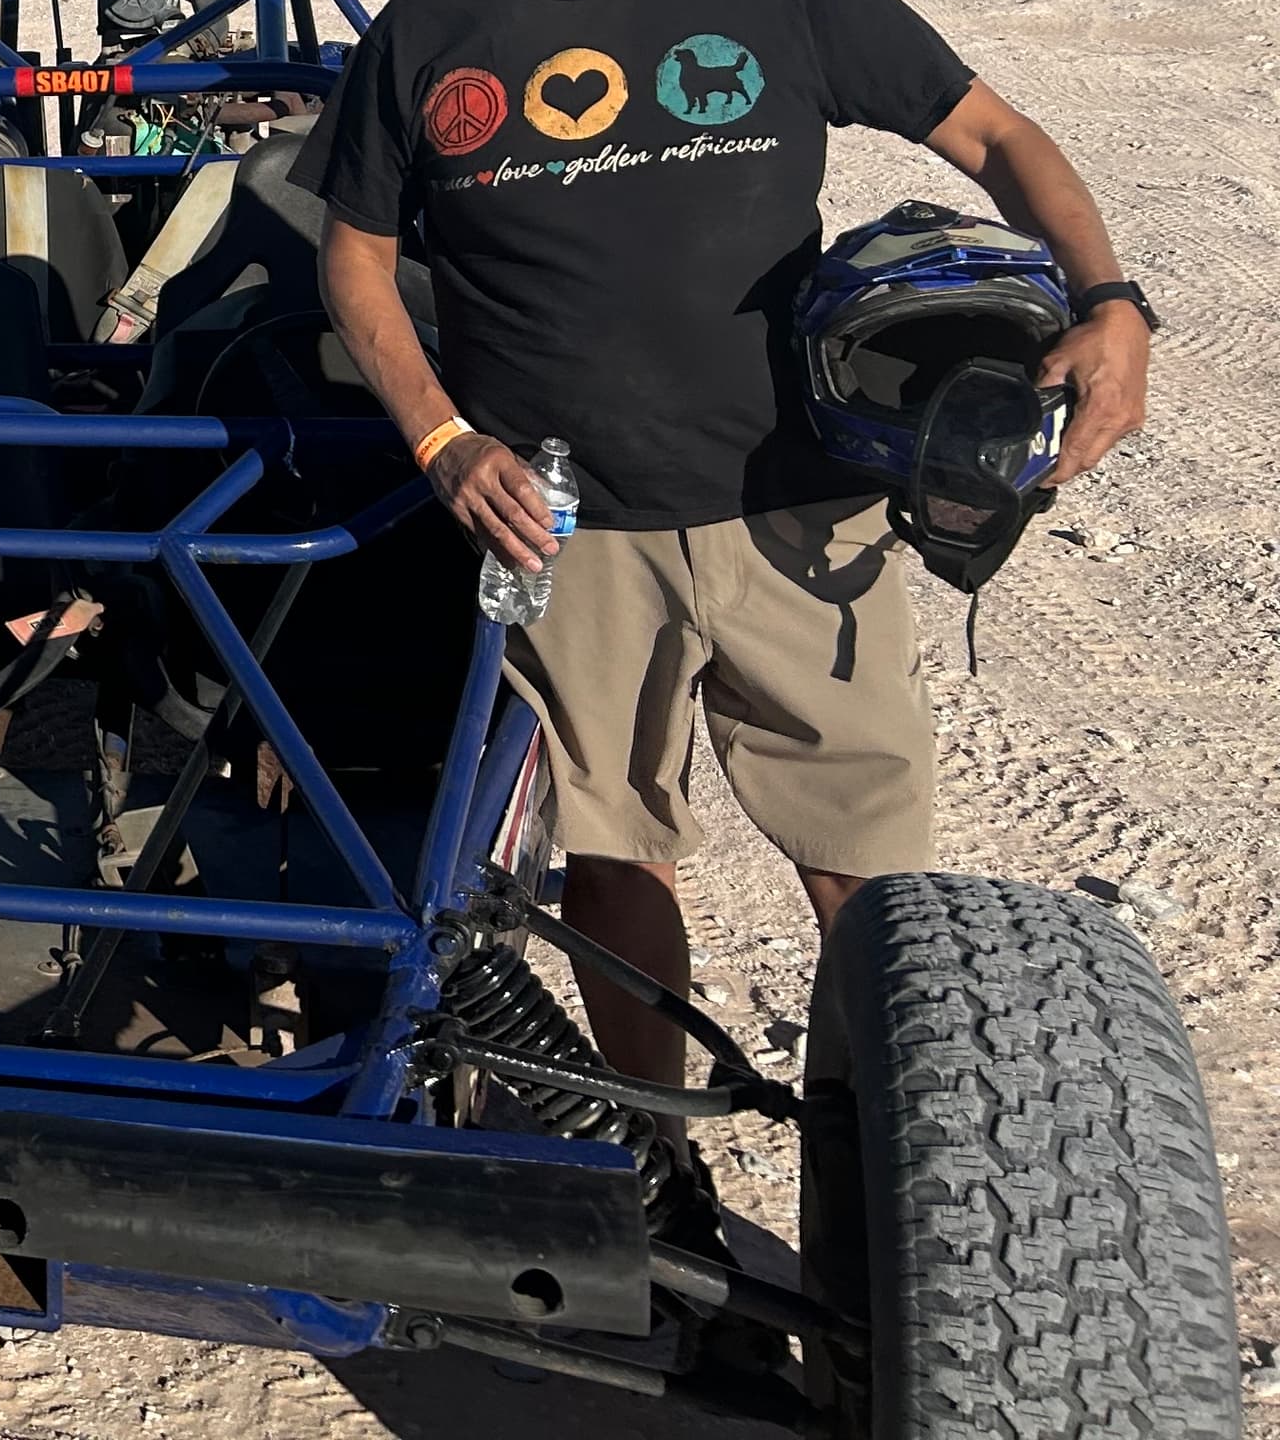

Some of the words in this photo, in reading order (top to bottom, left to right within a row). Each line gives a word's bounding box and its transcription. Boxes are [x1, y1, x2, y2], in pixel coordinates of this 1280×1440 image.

[36, 70, 110, 93] SB407
[492, 156, 545, 187] love
[562, 143, 653, 185] golden
[660, 131, 779, 162] retriever
